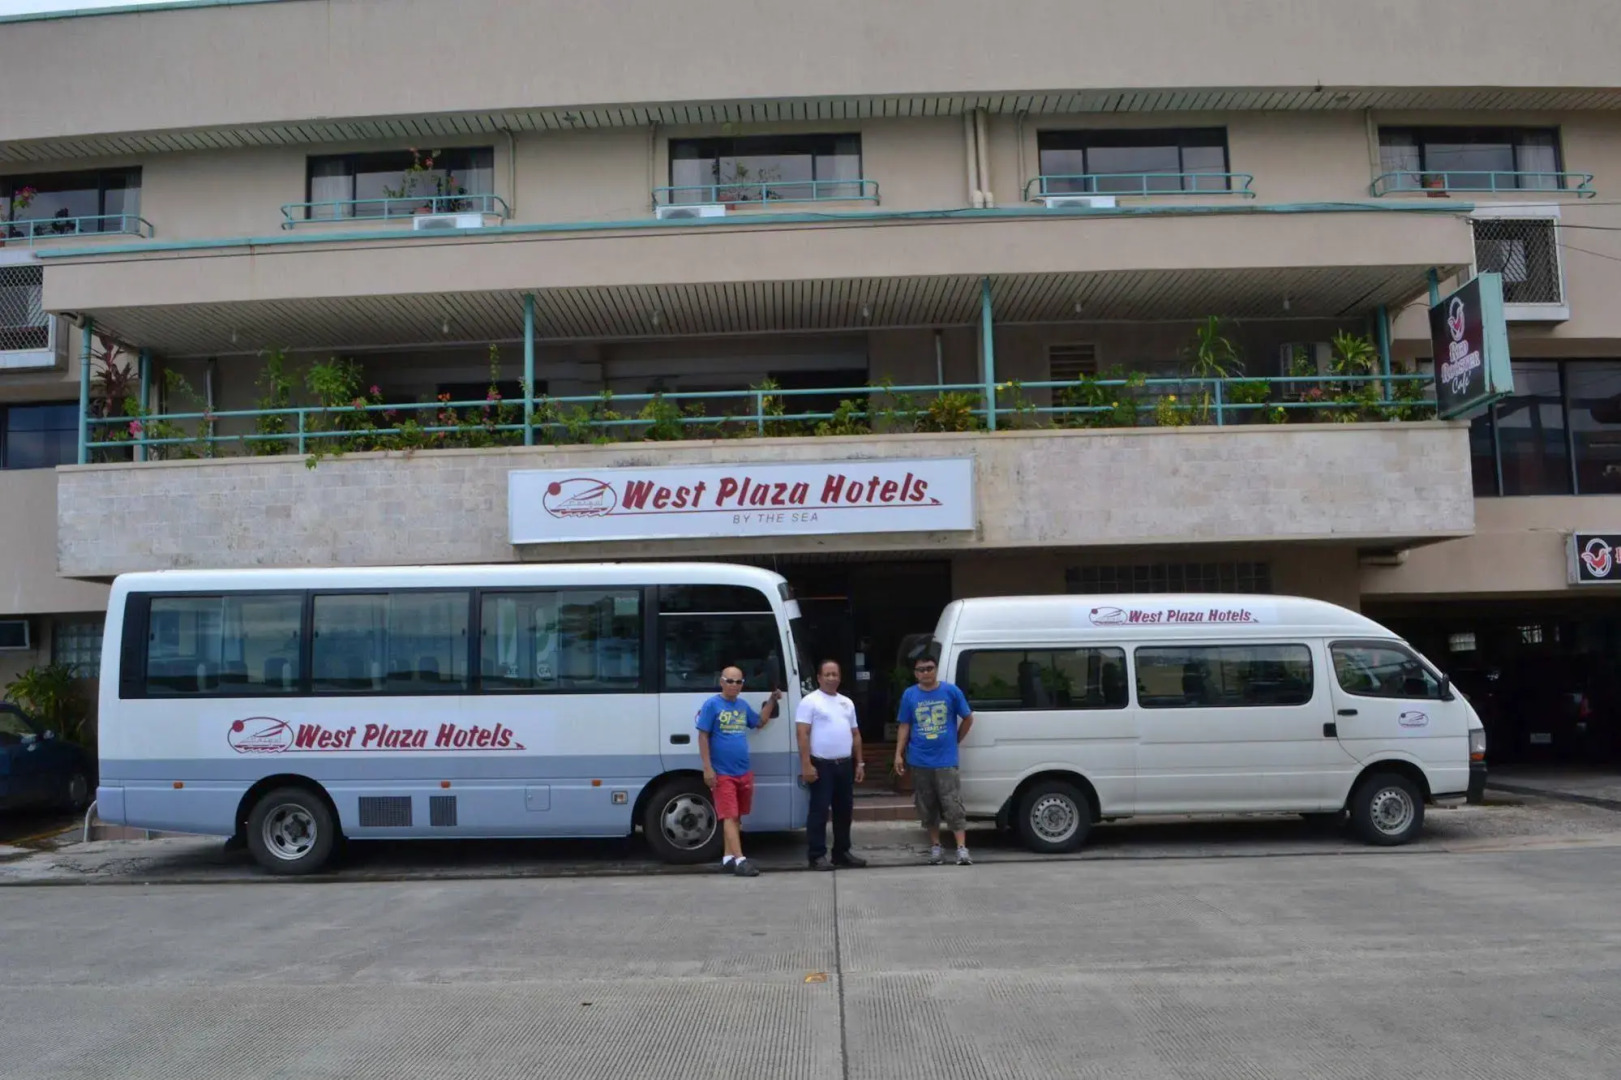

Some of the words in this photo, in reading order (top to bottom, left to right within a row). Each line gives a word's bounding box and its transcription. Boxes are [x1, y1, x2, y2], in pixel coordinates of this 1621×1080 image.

[622, 480, 706, 510] West
[715, 475, 810, 508] Plaza
[820, 472, 929, 504] Hotels
[732, 513, 751, 525] BY
[758, 513, 785, 524] THE
[792, 512, 819, 523] SEA
[1129, 610, 1163, 623] West
[1166, 609, 1204, 623] Plaza
[1208, 608, 1252, 622] Hotels
[295, 724, 356, 749] West
[361, 723, 429, 748] Plaza
[435, 721, 514, 748] Hotels
